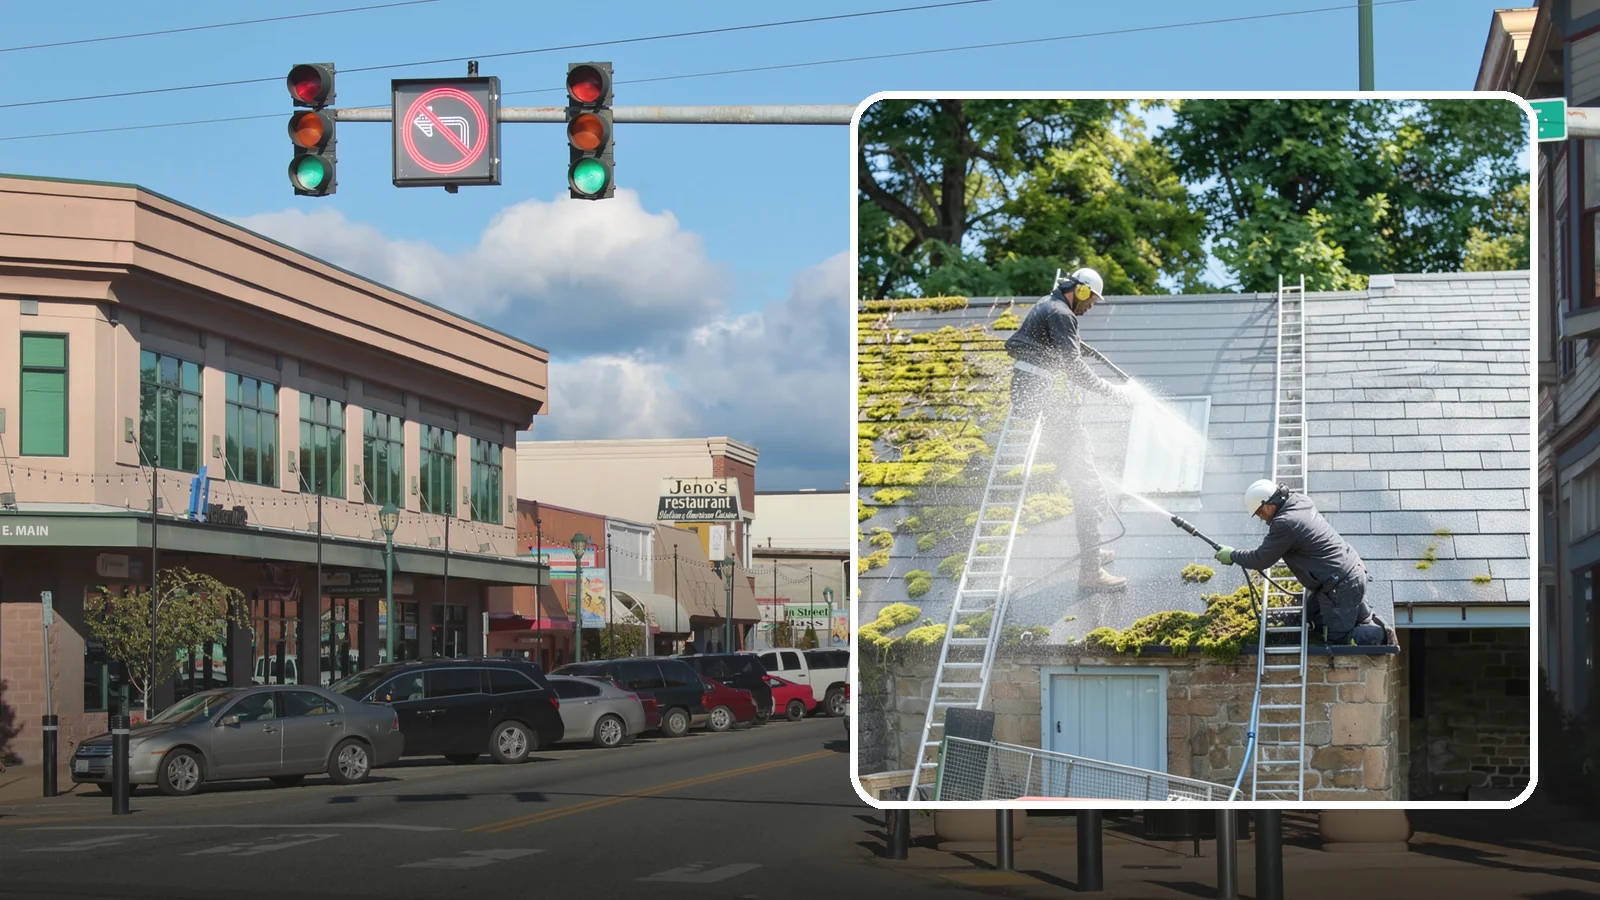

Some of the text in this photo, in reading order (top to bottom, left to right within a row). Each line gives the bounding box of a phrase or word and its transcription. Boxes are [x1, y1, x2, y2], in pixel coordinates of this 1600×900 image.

[669, 480, 728, 495] Jeno's
[665, 496, 731, 509] restaurant
[658, 510, 682, 520] Italian
[686, 510, 715, 519] American
[714, 509, 738, 519] Cuisine
[2, 525, 49, 536] E. MAIN
[797, 607, 829, 617] Street
[791, 619, 824, 627] lass
